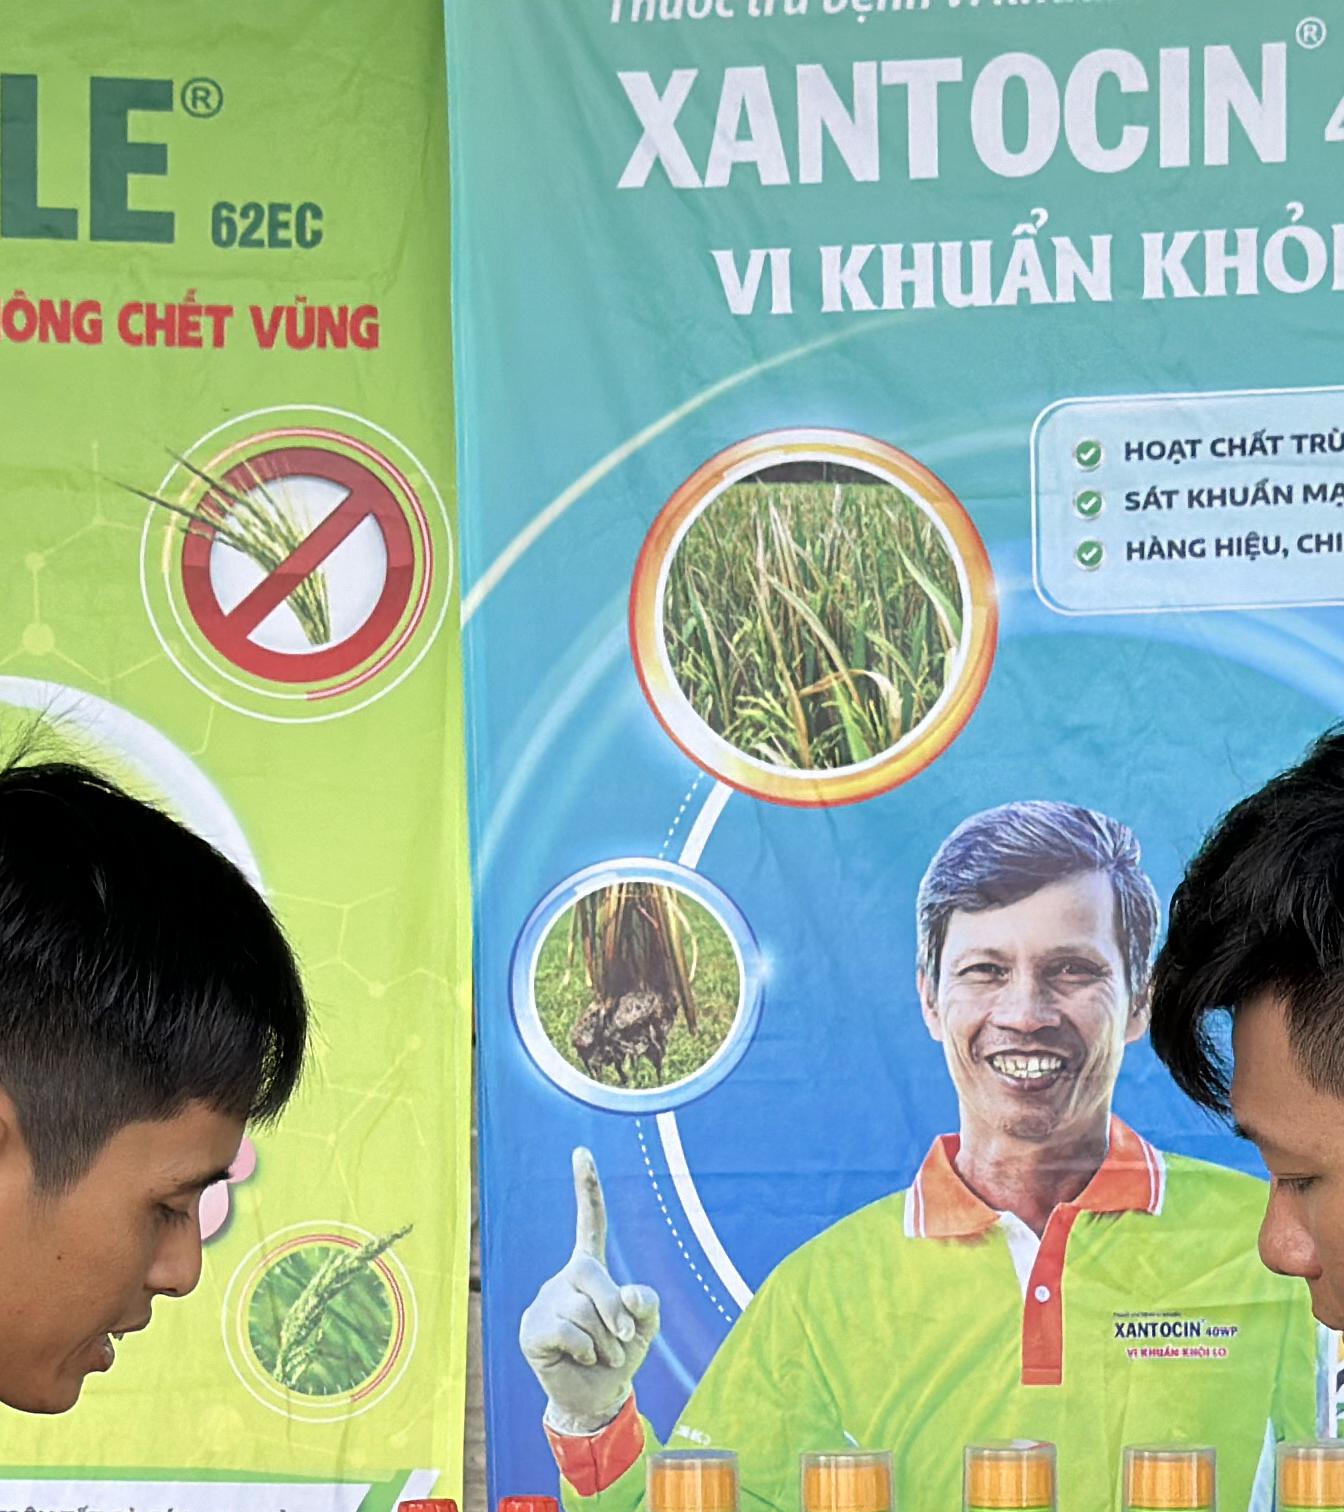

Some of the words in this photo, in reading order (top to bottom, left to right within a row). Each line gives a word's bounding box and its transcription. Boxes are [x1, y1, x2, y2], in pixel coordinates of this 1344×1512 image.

[211, 201, 322, 249] 62EC
[711, 248, 793, 315] VI
[819, 208, 1113, 313] KHUẨN
[118, 289, 233, 348] CHẾT
[249, 297, 380, 349] VŨNG
[1125, 438, 1202, 464] HOẠT
[1210, 429, 1284, 458] CHẤT
[1125, 486, 1179, 511] SÁT
[1187, 478, 1293, 508] KHUẨN
[1126, 535, 1206, 562] HÀNG
[1215, 531, 1289, 561] HIỆU,
[1297, 532, 1343, 554] CHI
[1115, 1321, 1200, 1338] XANTOCIN
